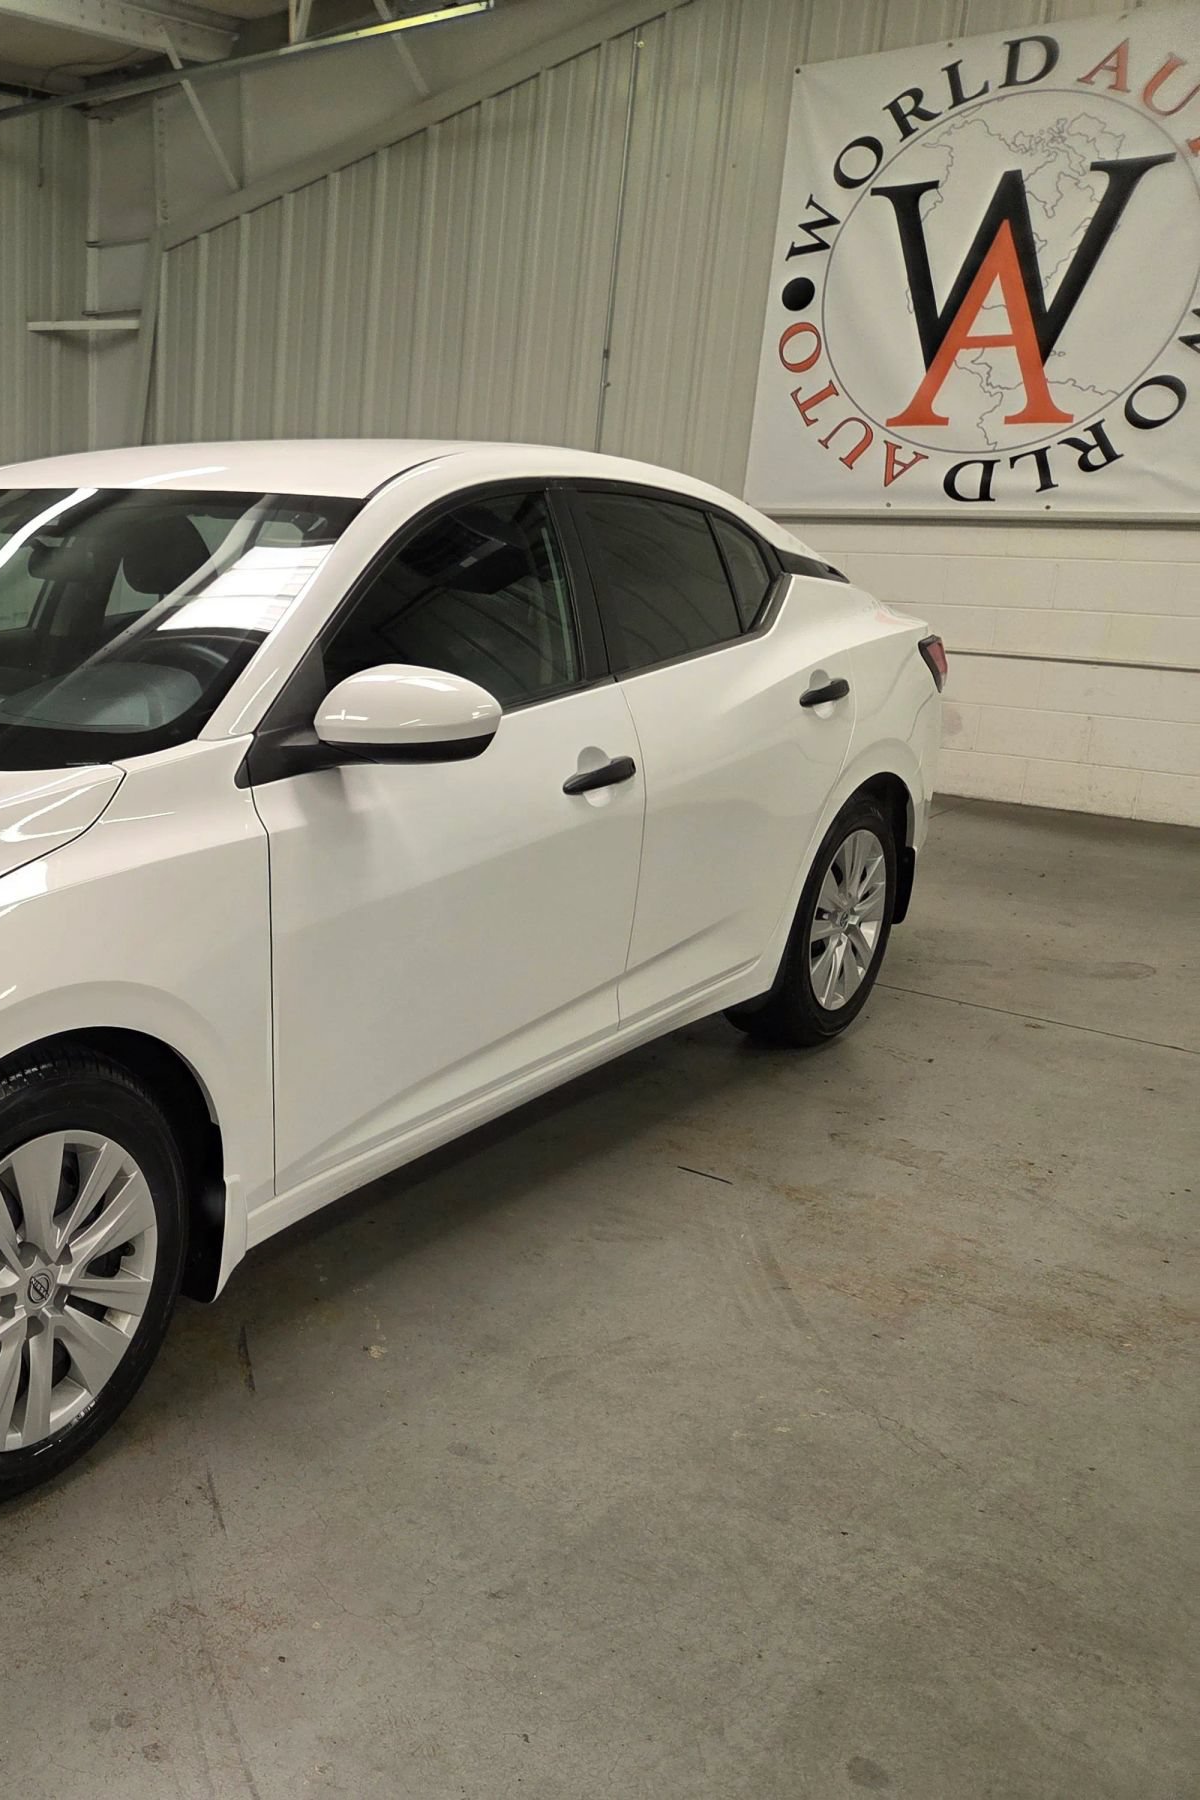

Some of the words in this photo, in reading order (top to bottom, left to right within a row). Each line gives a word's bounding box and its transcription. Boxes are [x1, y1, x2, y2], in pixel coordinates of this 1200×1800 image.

[785, 35, 1060, 262] WORLD
[1076, 38, 1200, 157] AU
[778, 322, 929, 487] AUTO
